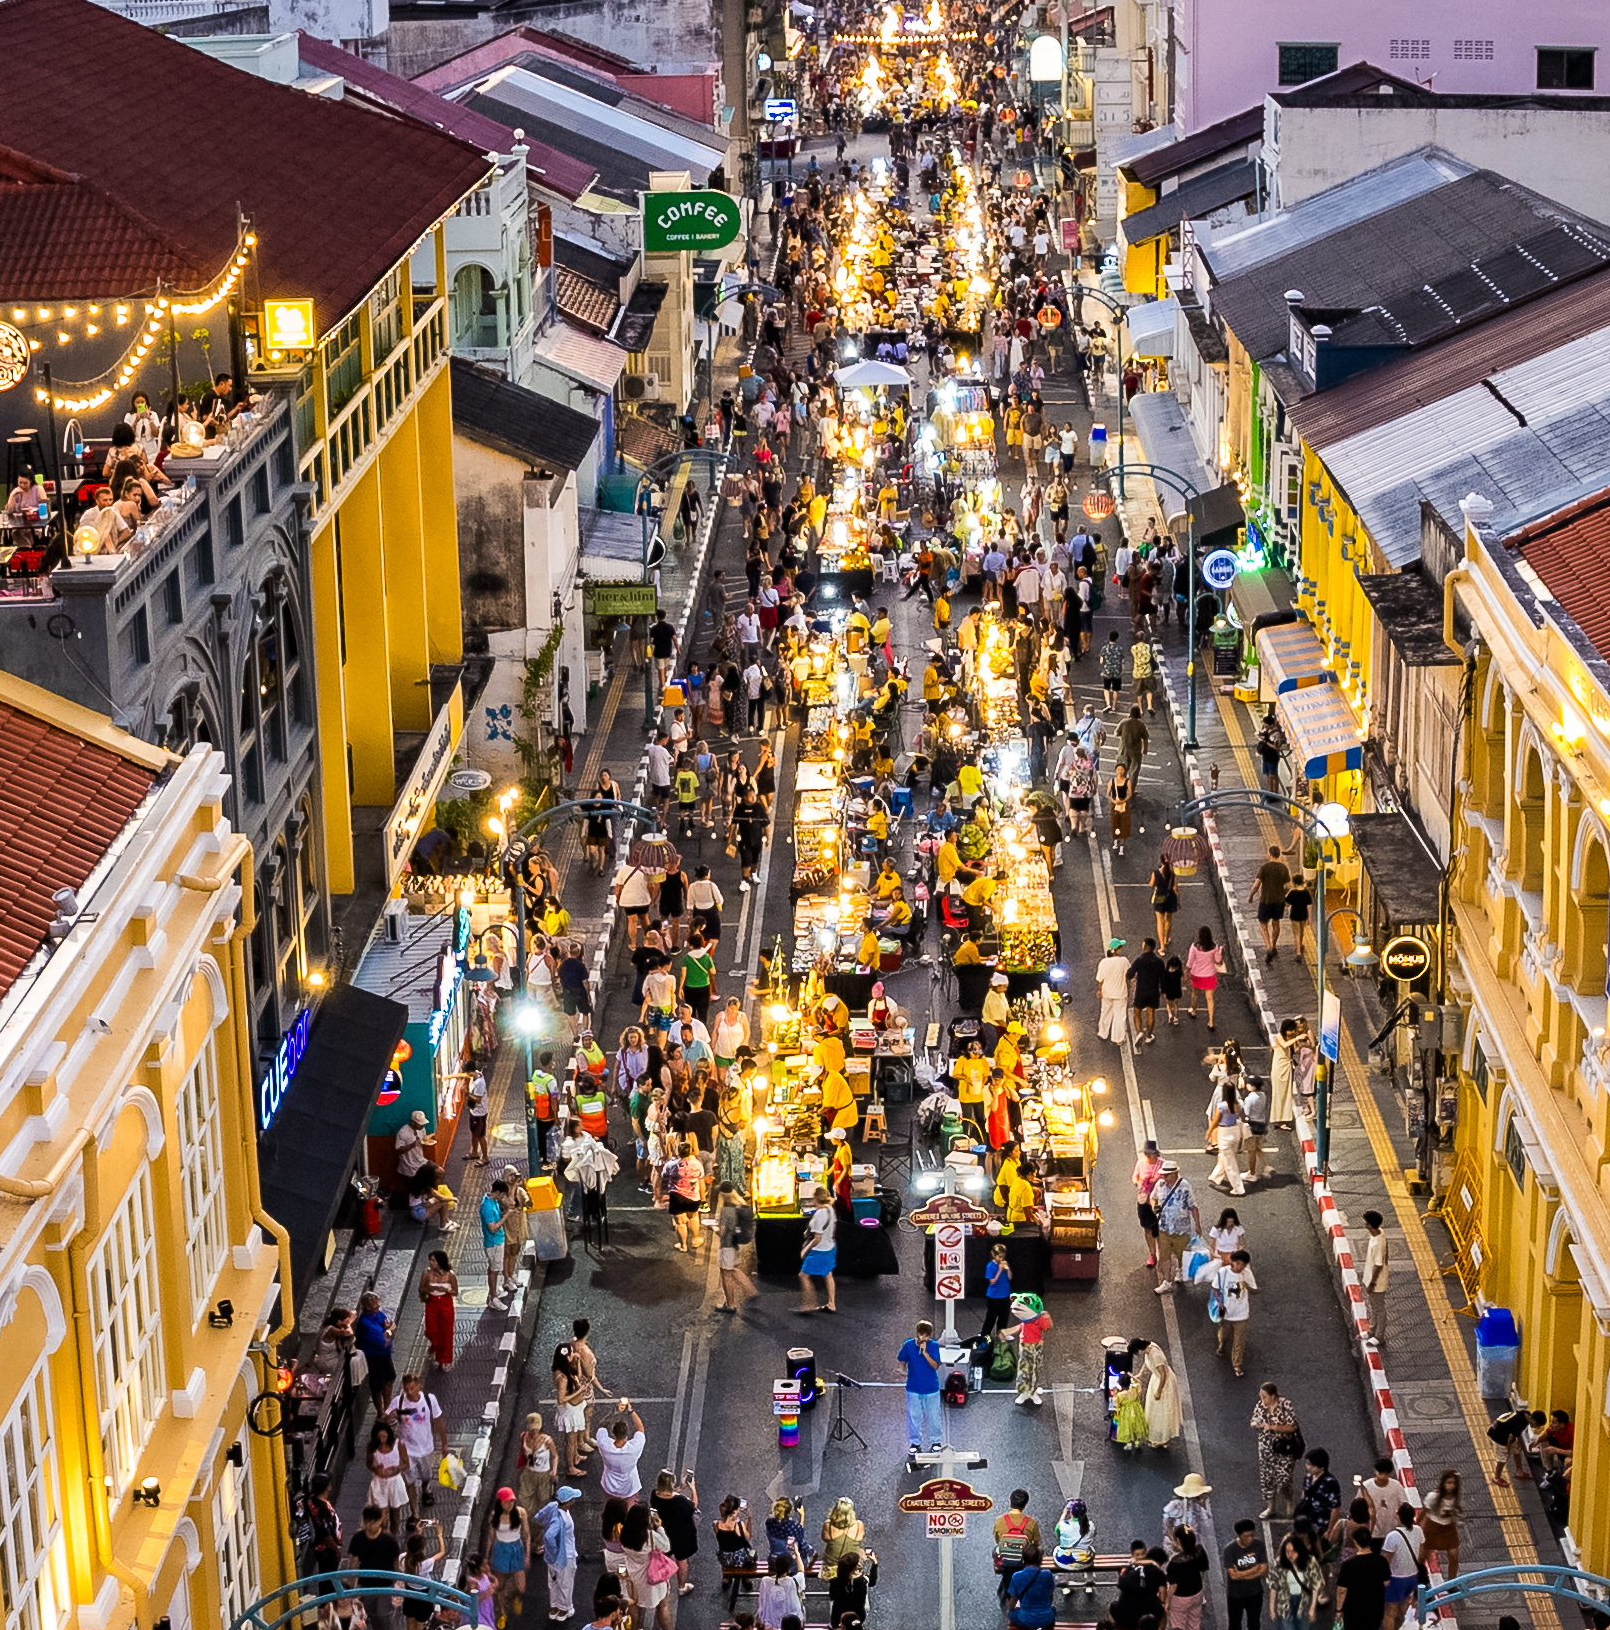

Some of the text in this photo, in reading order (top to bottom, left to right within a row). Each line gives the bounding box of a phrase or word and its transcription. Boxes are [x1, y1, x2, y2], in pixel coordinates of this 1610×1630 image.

[657, 201, 728, 229] COMFEE
[666, 233, 690, 241] COFFEE
[929, 1514, 946, 1527] NO
[928, 1527, 964, 1535] SMOKING
